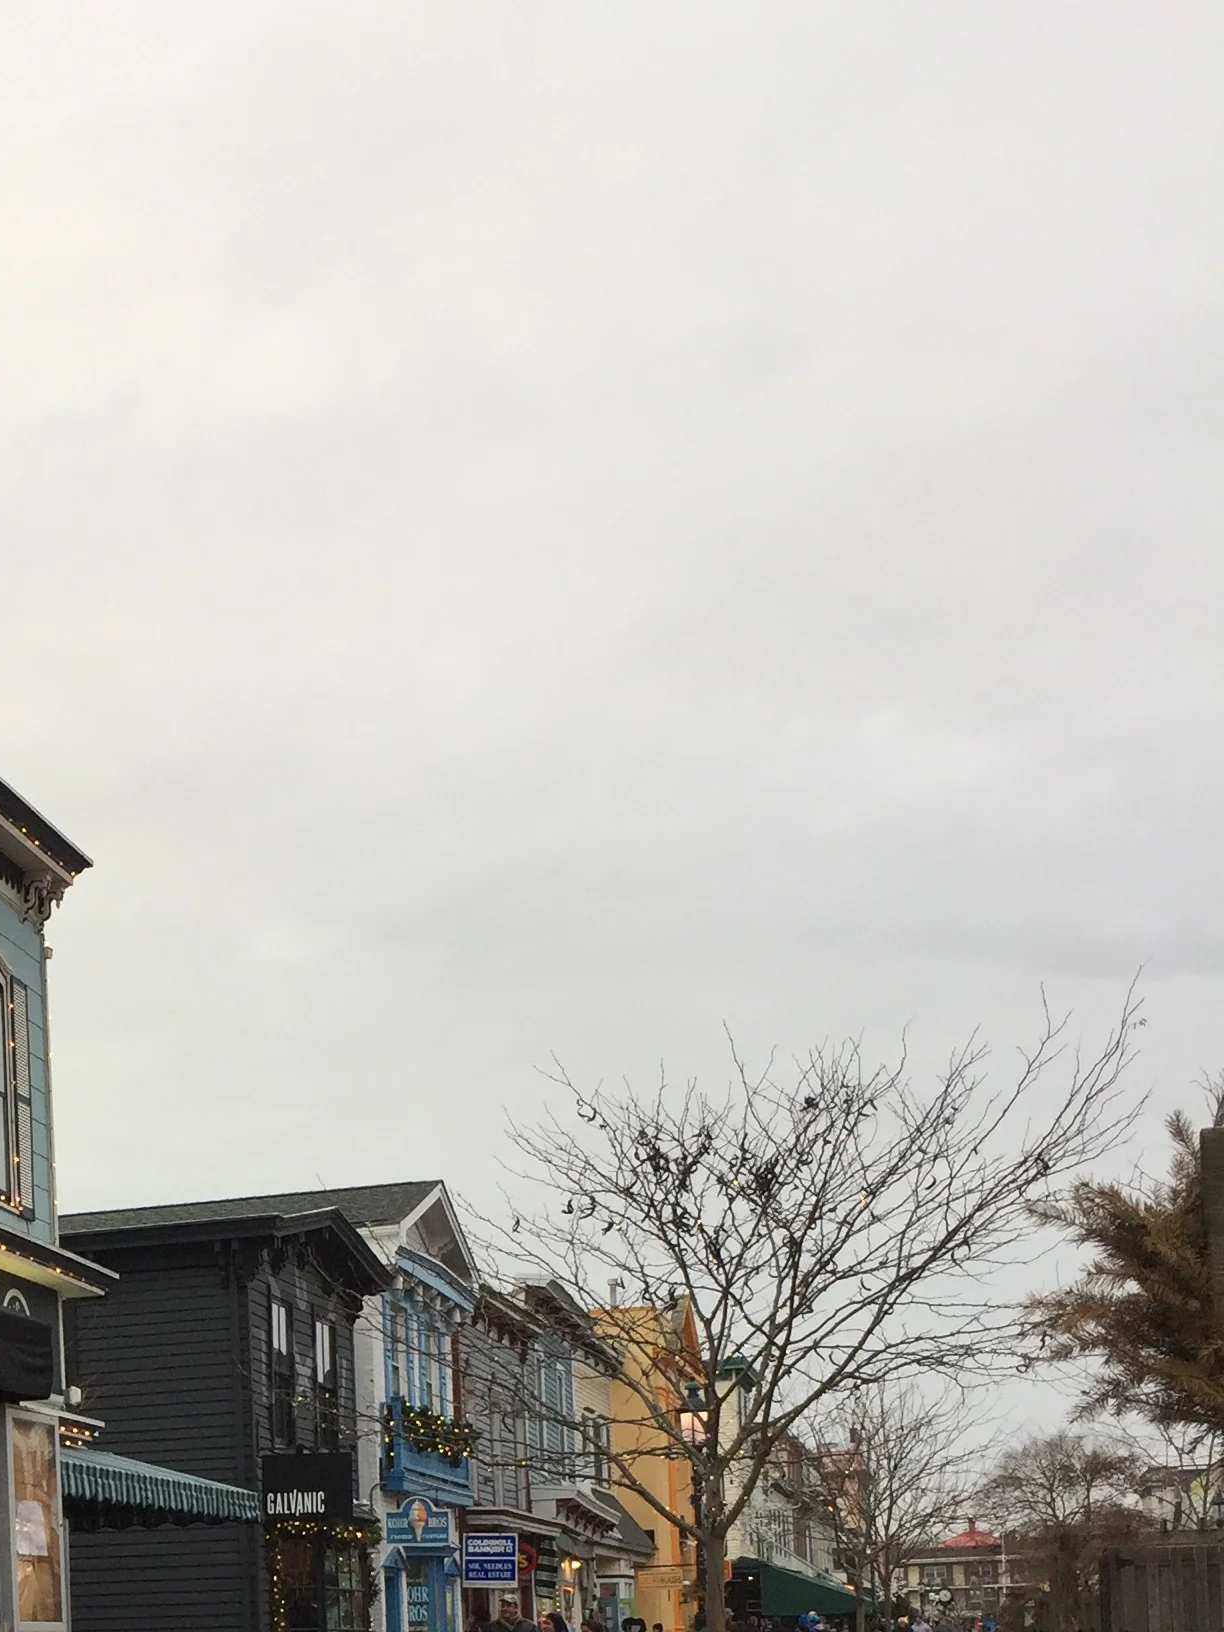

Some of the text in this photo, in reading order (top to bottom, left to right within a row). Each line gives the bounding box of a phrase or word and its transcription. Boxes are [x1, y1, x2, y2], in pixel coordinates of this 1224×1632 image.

[266, 1489, 325, 1516] GALVANIC
[467, 1571, 487, 1579] REAL
[407, 1586, 430, 1602] OHR
[407, 1604, 429, 1621] ROS
